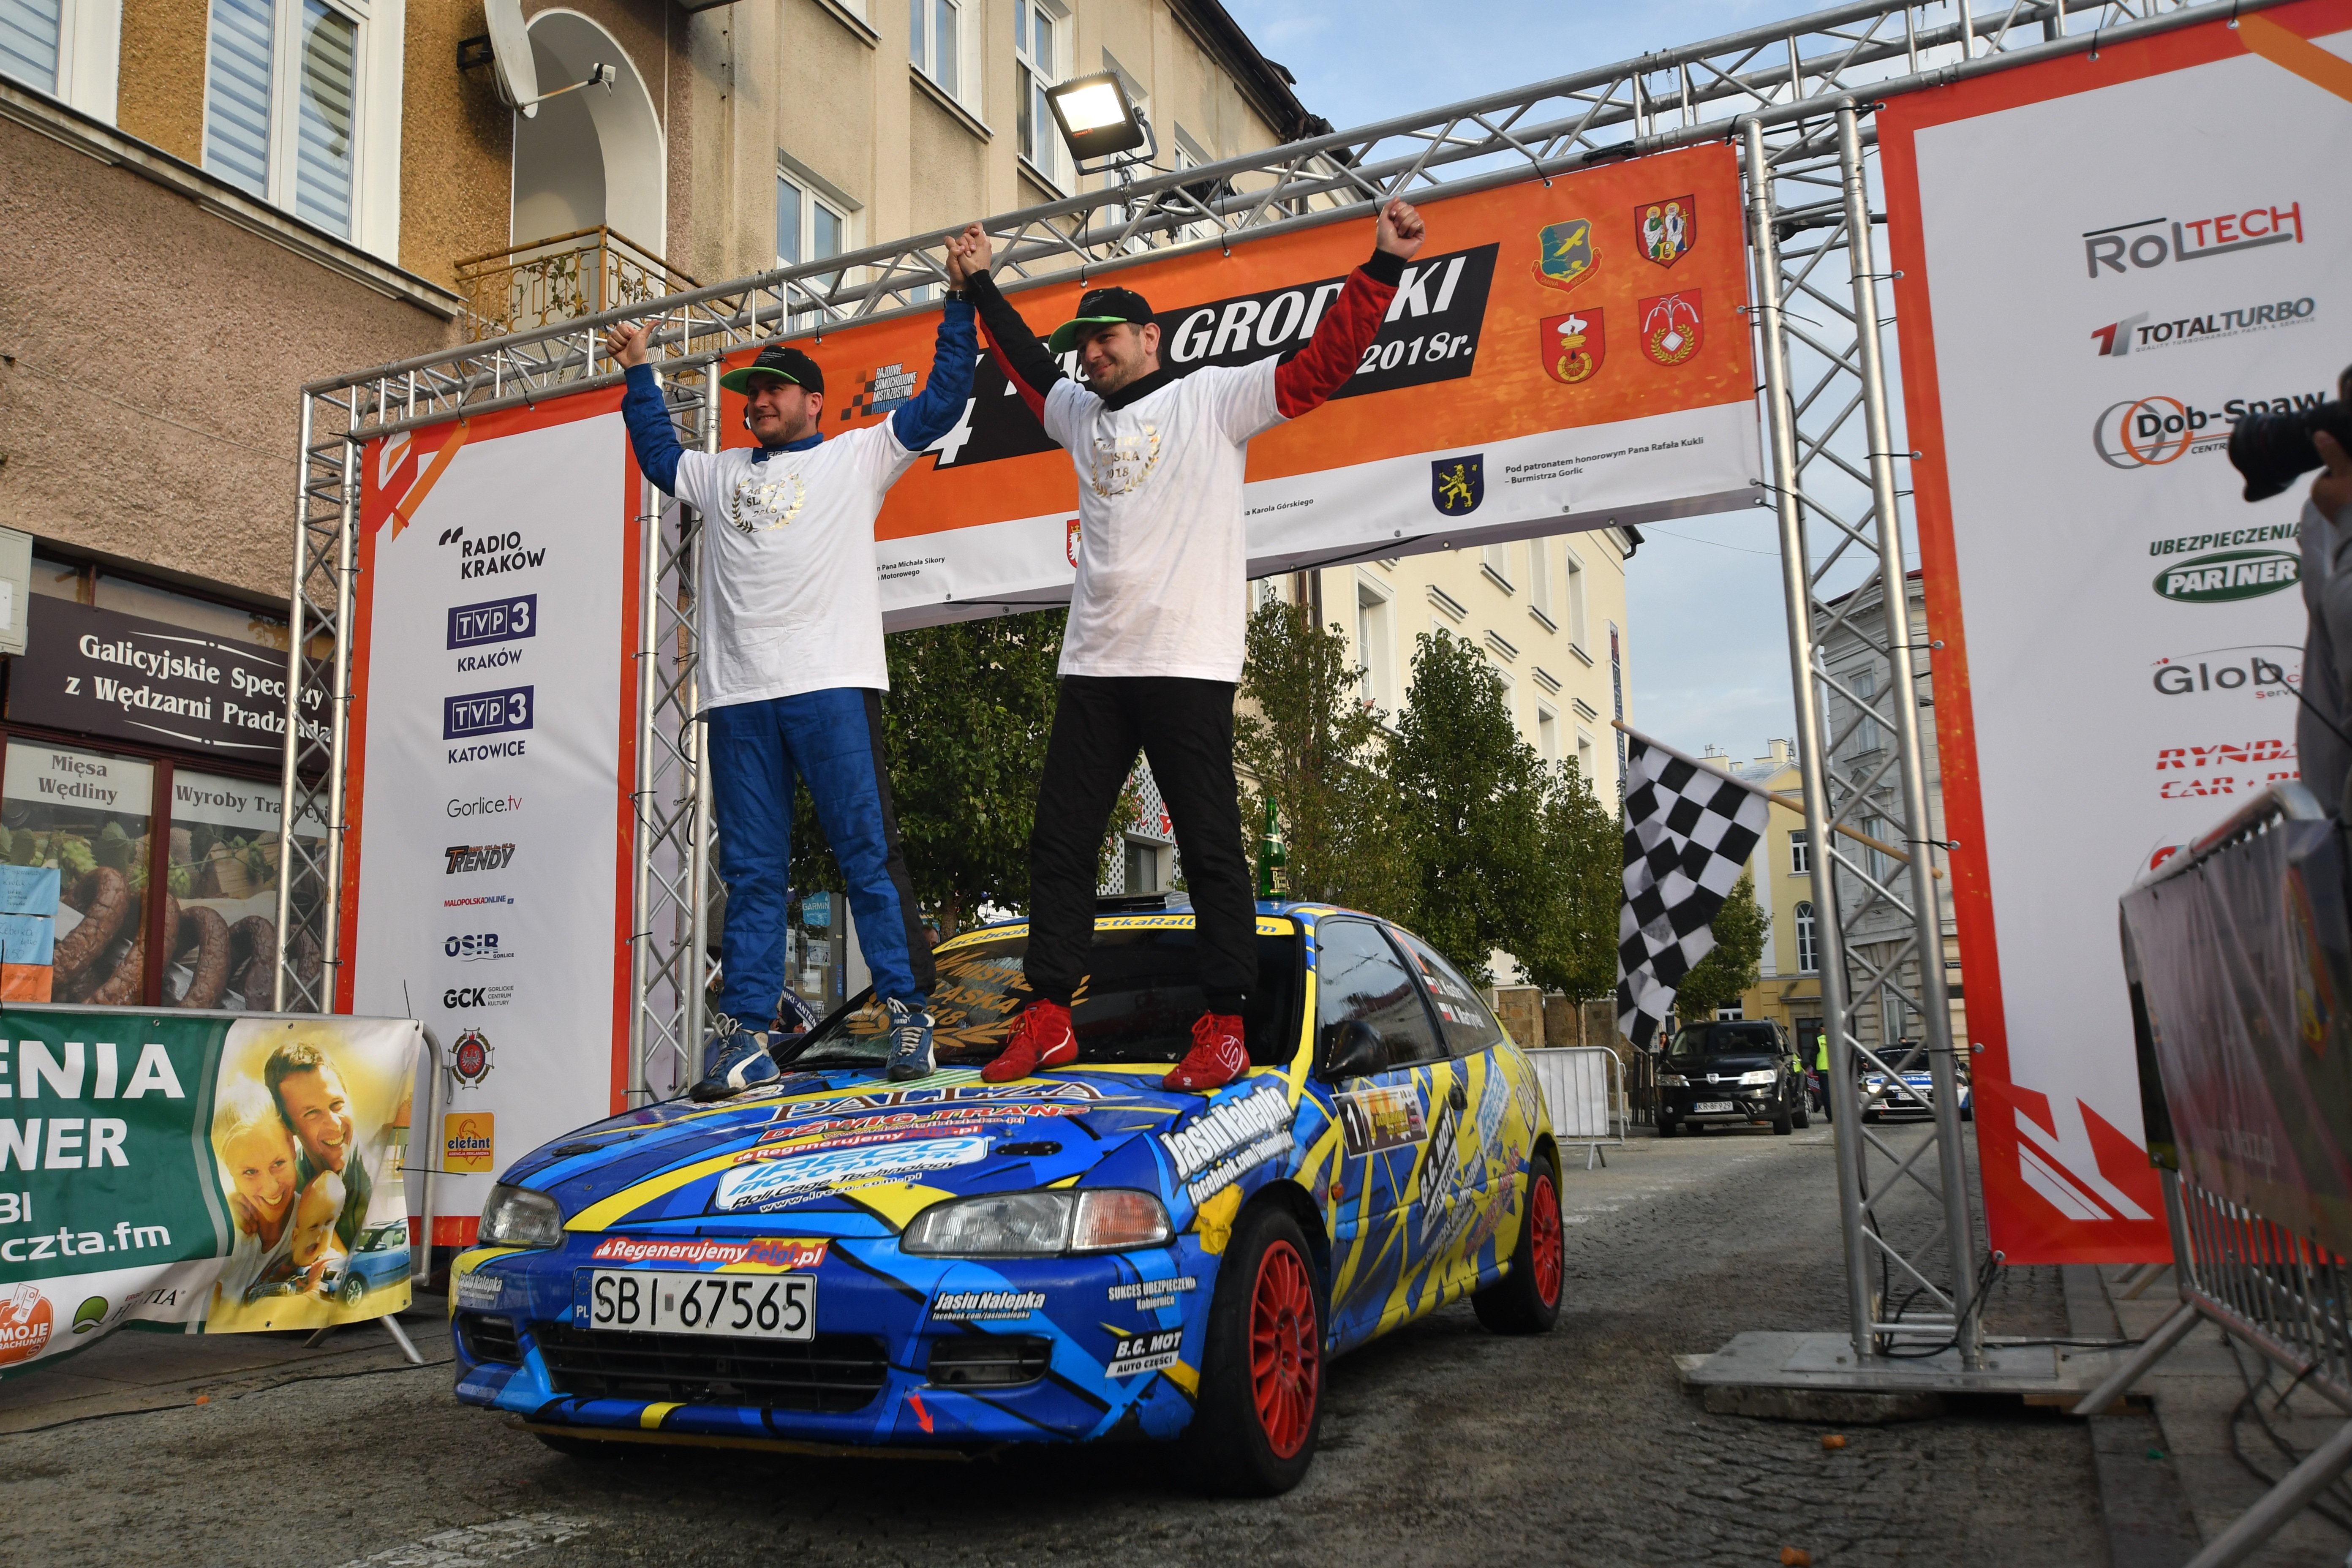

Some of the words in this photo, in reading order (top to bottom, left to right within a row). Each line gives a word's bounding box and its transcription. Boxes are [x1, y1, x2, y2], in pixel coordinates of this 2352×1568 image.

[2085, 201, 2304, 279] ROLTECH
[1540, 277, 1558, 287] GMINA
[2136, 297, 2315, 346] TOTALTURBO
[2241, 325, 2268, 334] PARTS
[1355, 331, 1473, 375] 2018r.
[874, 371, 917, 392] SAMOCHODOWE
[875, 362, 903, 380] RAJDOWE
[872, 384, 913, 403] MISTRZOSTWA
[1505, 465, 1522, 474] Pod
[1524, 458, 1573, 473] patronatem
[1575, 449, 1626, 464] honorowym
[1628, 445, 1649, 454] Pana
[1651, 441, 1679, 451] Rafała
[1681, 437, 1704, 447] Kukli
[2191, 442, 2228, 455] CENTR
[1511, 471, 1557, 485] Burmistrza
[1559, 466, 1584, 476] Gorlic
[1252, 505, 1275, 515] Karola
[1277, 498, 1314, 510] Górskiego
[463, 531, 521, 558] RADIO
[461, 546, 546, 580] KRAKÓW
[881, 569, 920, 580] Motorowego
[898, 559, 923, 568] Michała
[2166, 560, 2297, 595] PARTNER
[460, 611, 503, 636] TVP
[512, 602, 529, 632] 3
[79, 634, 220, 684] Galicyjskie
[457, 647, 523, 672] KRAKÓW
[65, 676, 81, 696] z
[95, 676, 211, 720] Wędzarni
[456, 702, 501, 726] TVP
[509, 693, 527, 724] 3
[448, 740, 525, 764] KATOWICE
[52, 755, 107, 778] Mięsa
[39, 777, 118, 805] Wędliny
[176, 785, 247, 812] Wyroby
[2160, 776, 2234, 798] CAR
[447, 795, 522, 817] Gorlice.tv
[445, 845, 515, 874] TRENDY
[803, 902, 829, 910] GARMIN
[444, 987, 486, 1008] GCK
[0, 1040, 185, 1098] NIA
[760, 1105, 1091, 1141] DŹWIG-TRANS
[1347, 1103, 1361, 1146] 1
[448, 1137, 490, 1149] elefant
[1, 1222, 171, 1262] czta.fm
[611, 1240, 823, 1267] RegenerujemyFelgi.pl
[1108, 1288, 1141, 1300] SUKCES
[1143, 1278, 1196, 1296] UBEZPIECZENIA
[577, 1305, 589, 1318] PL
[595, 1276, 659, 1325] SBI
[680, 1279, 807, 1331] 67565
[1136, 1295, 1175, 1310] Kobiernice
[1150, 1331, 1181, 1350] MOT
[1116, 1362, 1141, 1373] AUTO
